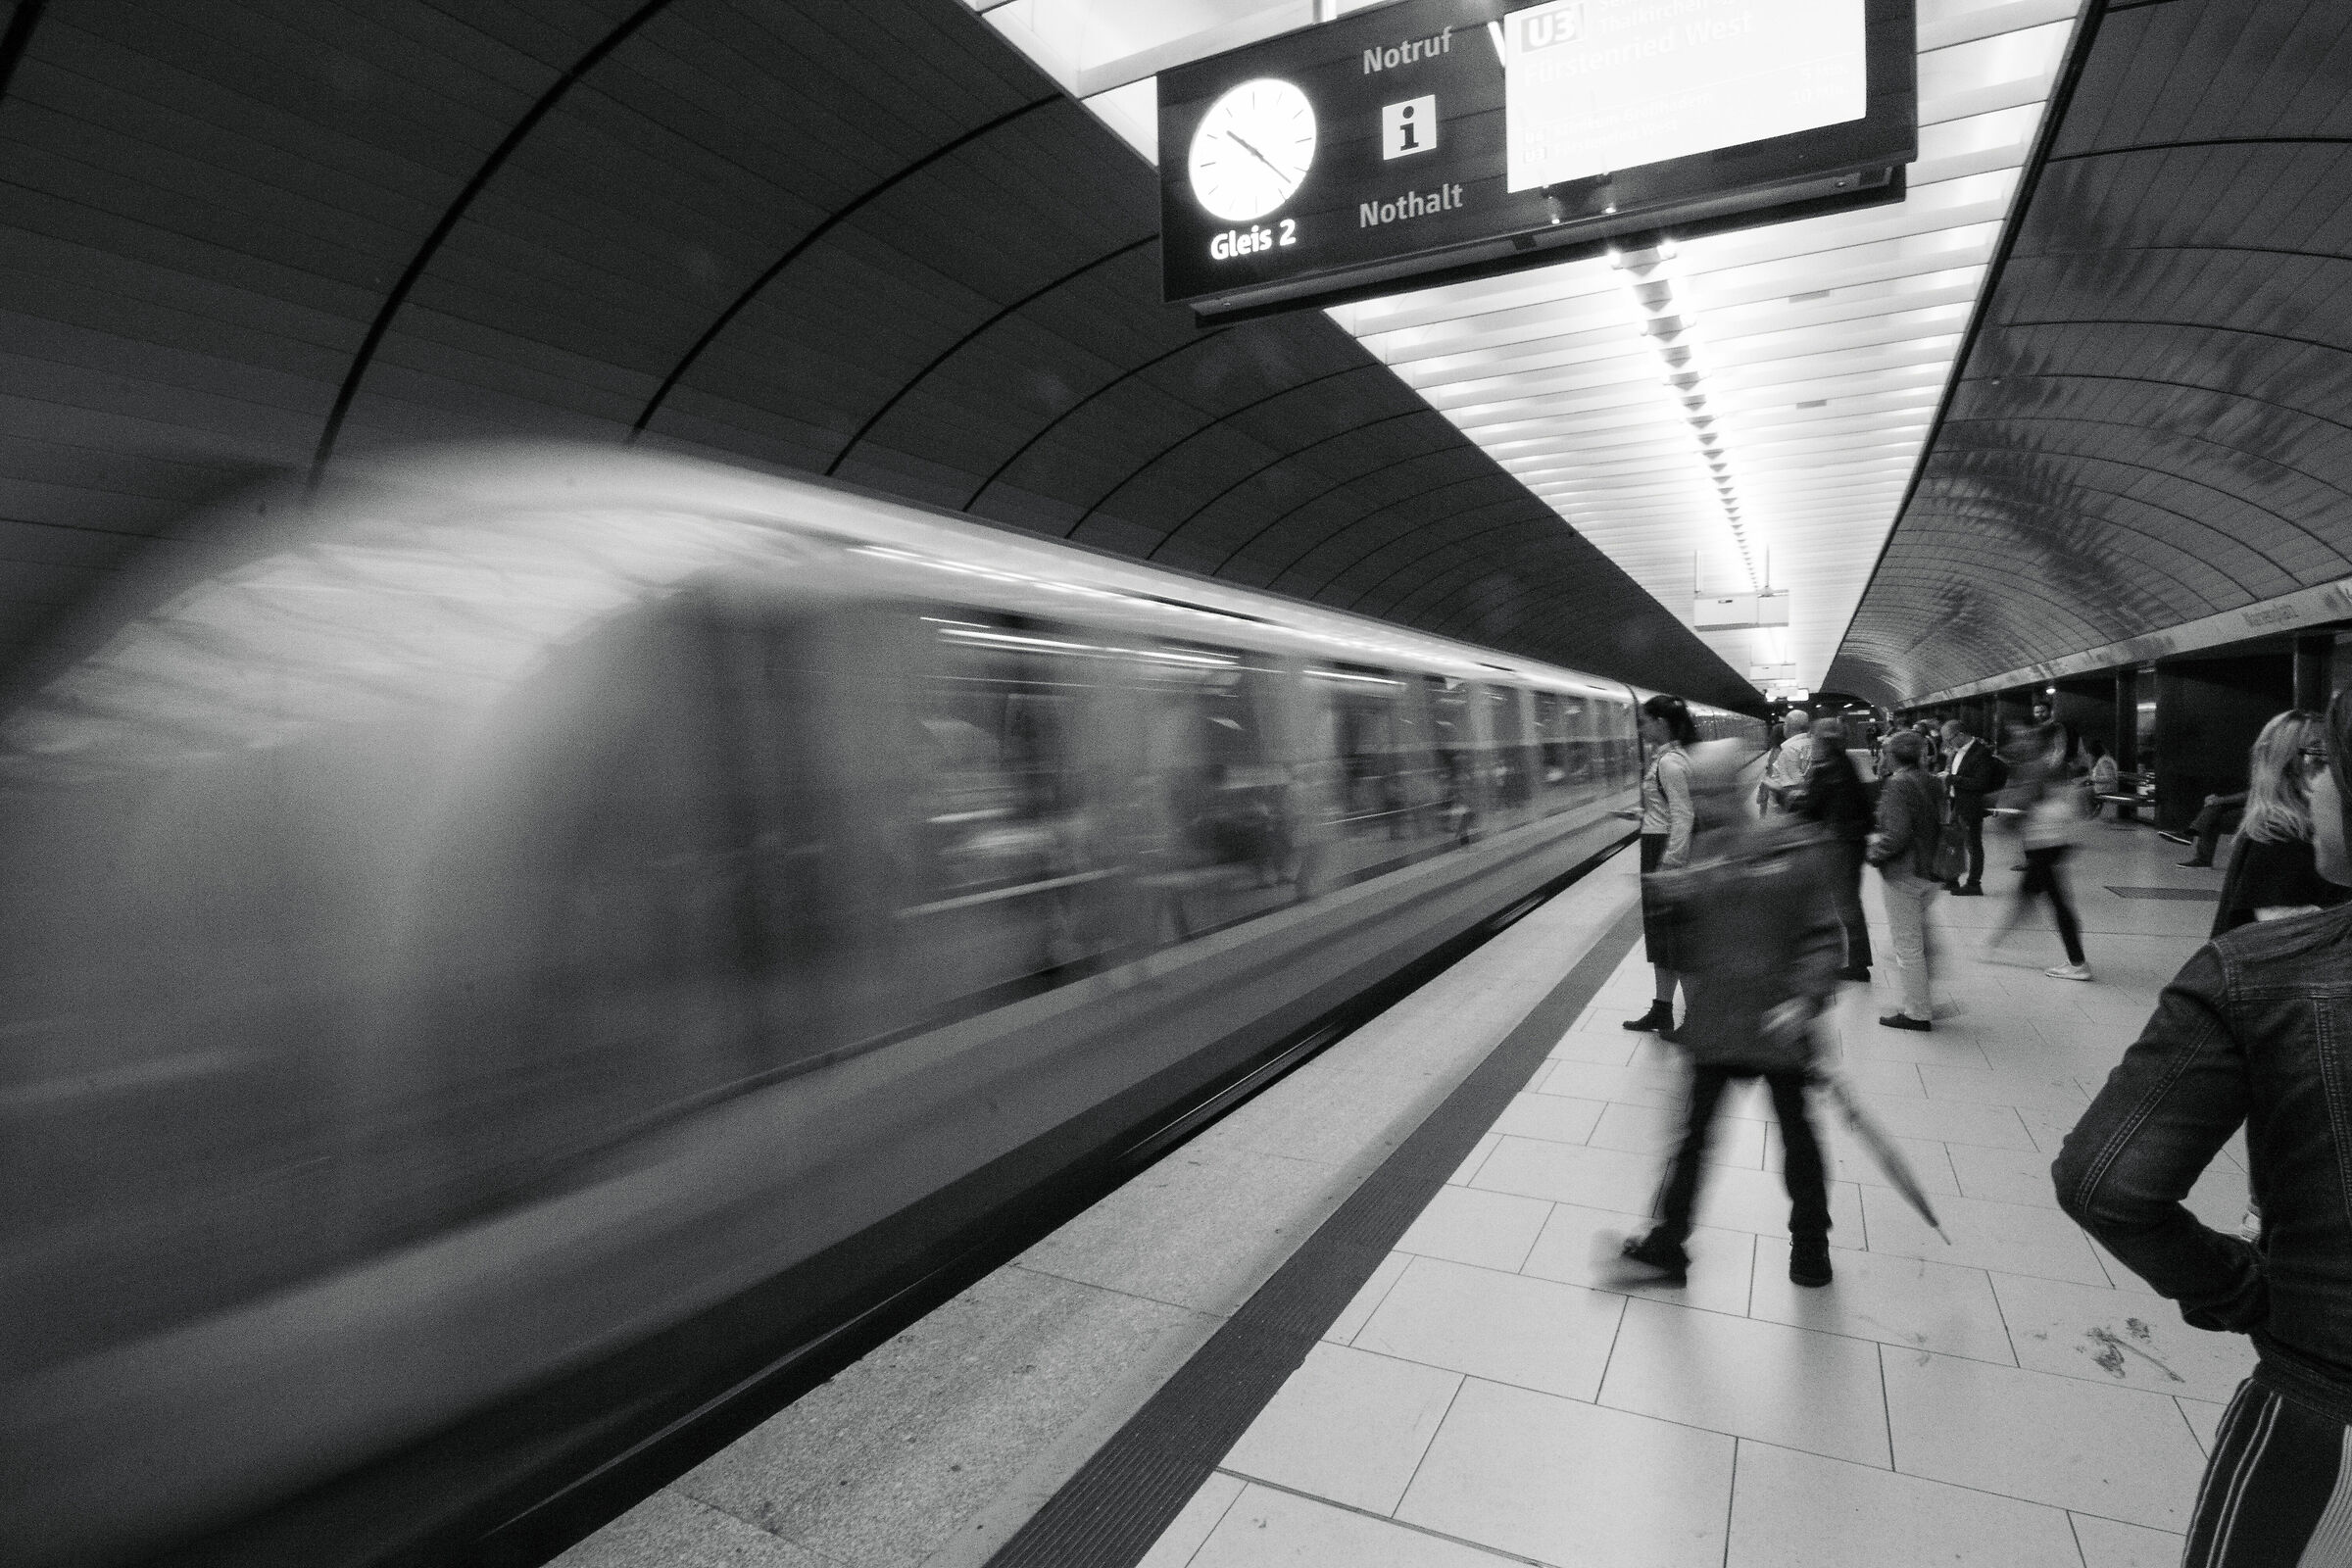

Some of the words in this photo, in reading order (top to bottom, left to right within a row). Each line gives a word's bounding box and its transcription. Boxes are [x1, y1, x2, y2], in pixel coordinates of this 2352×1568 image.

[1363, 25, 1453, 74] Notruf
[1524, 25, 1677, 86] Fürstenried
[1685, 10, 1755, 47] West
[1530, 11, 1576, 47] U3
[1359, 183, 1463, 228] Nothalt
[1210, 224, 1272, 260] Gleis
[1279, 219, 1297, 246] 2
